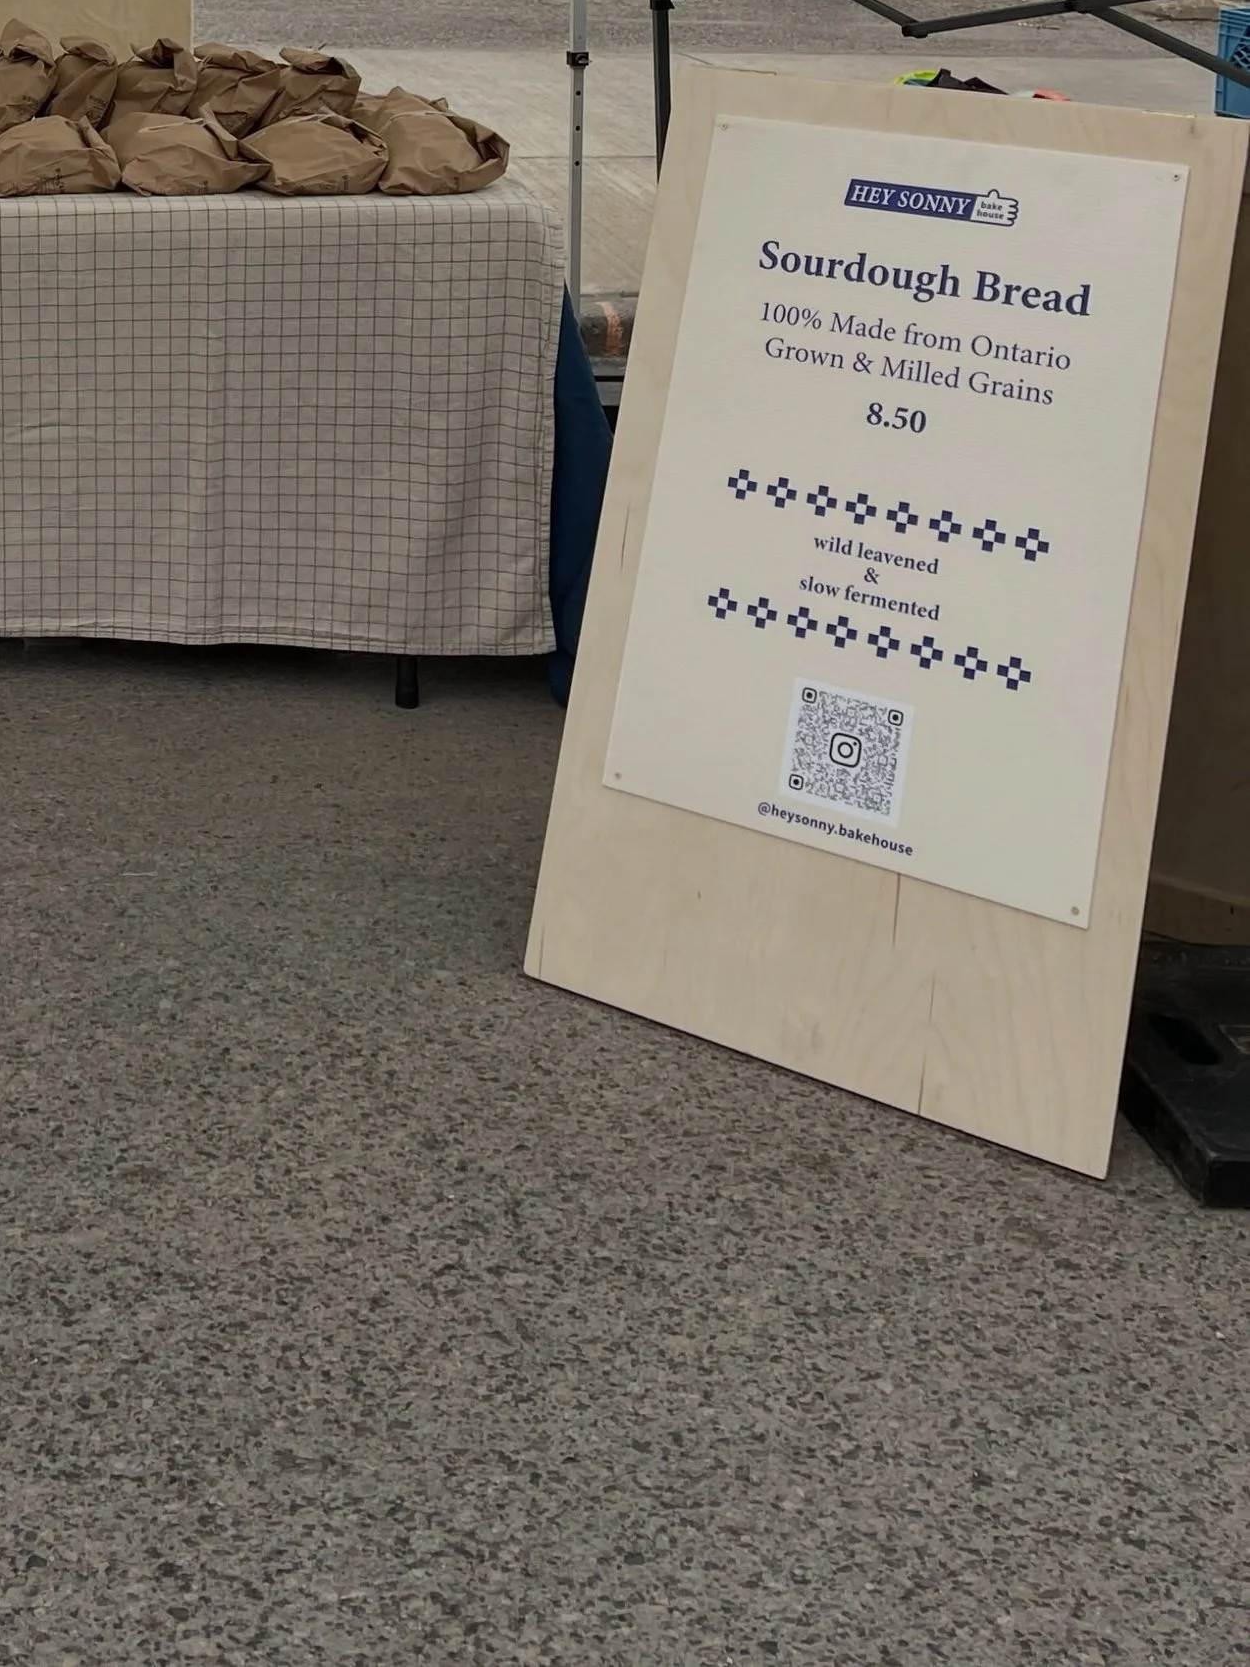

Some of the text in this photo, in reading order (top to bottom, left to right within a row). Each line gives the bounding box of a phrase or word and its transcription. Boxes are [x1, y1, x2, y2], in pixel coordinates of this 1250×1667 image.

[851, 184, 971, 216] HEY SONNY
[977, 209, 1005, 221] house
[980, 201, 1003, 212] bake
[759, 240, 1091, 316] Sourdough Bread
[760, 302, 1071, 371] 100% Made from Ontario
[765, 337, 1054, 405] Grown & Milled Grains
[866, 402, 927, 434] 8.50
[814, 536, 939, 575] wild leavened
[863, 567, 880, 585] &
[799, 576, 940, 621] slow fermented
[757, 801, 913, 856] @heysonny.bakehouse
